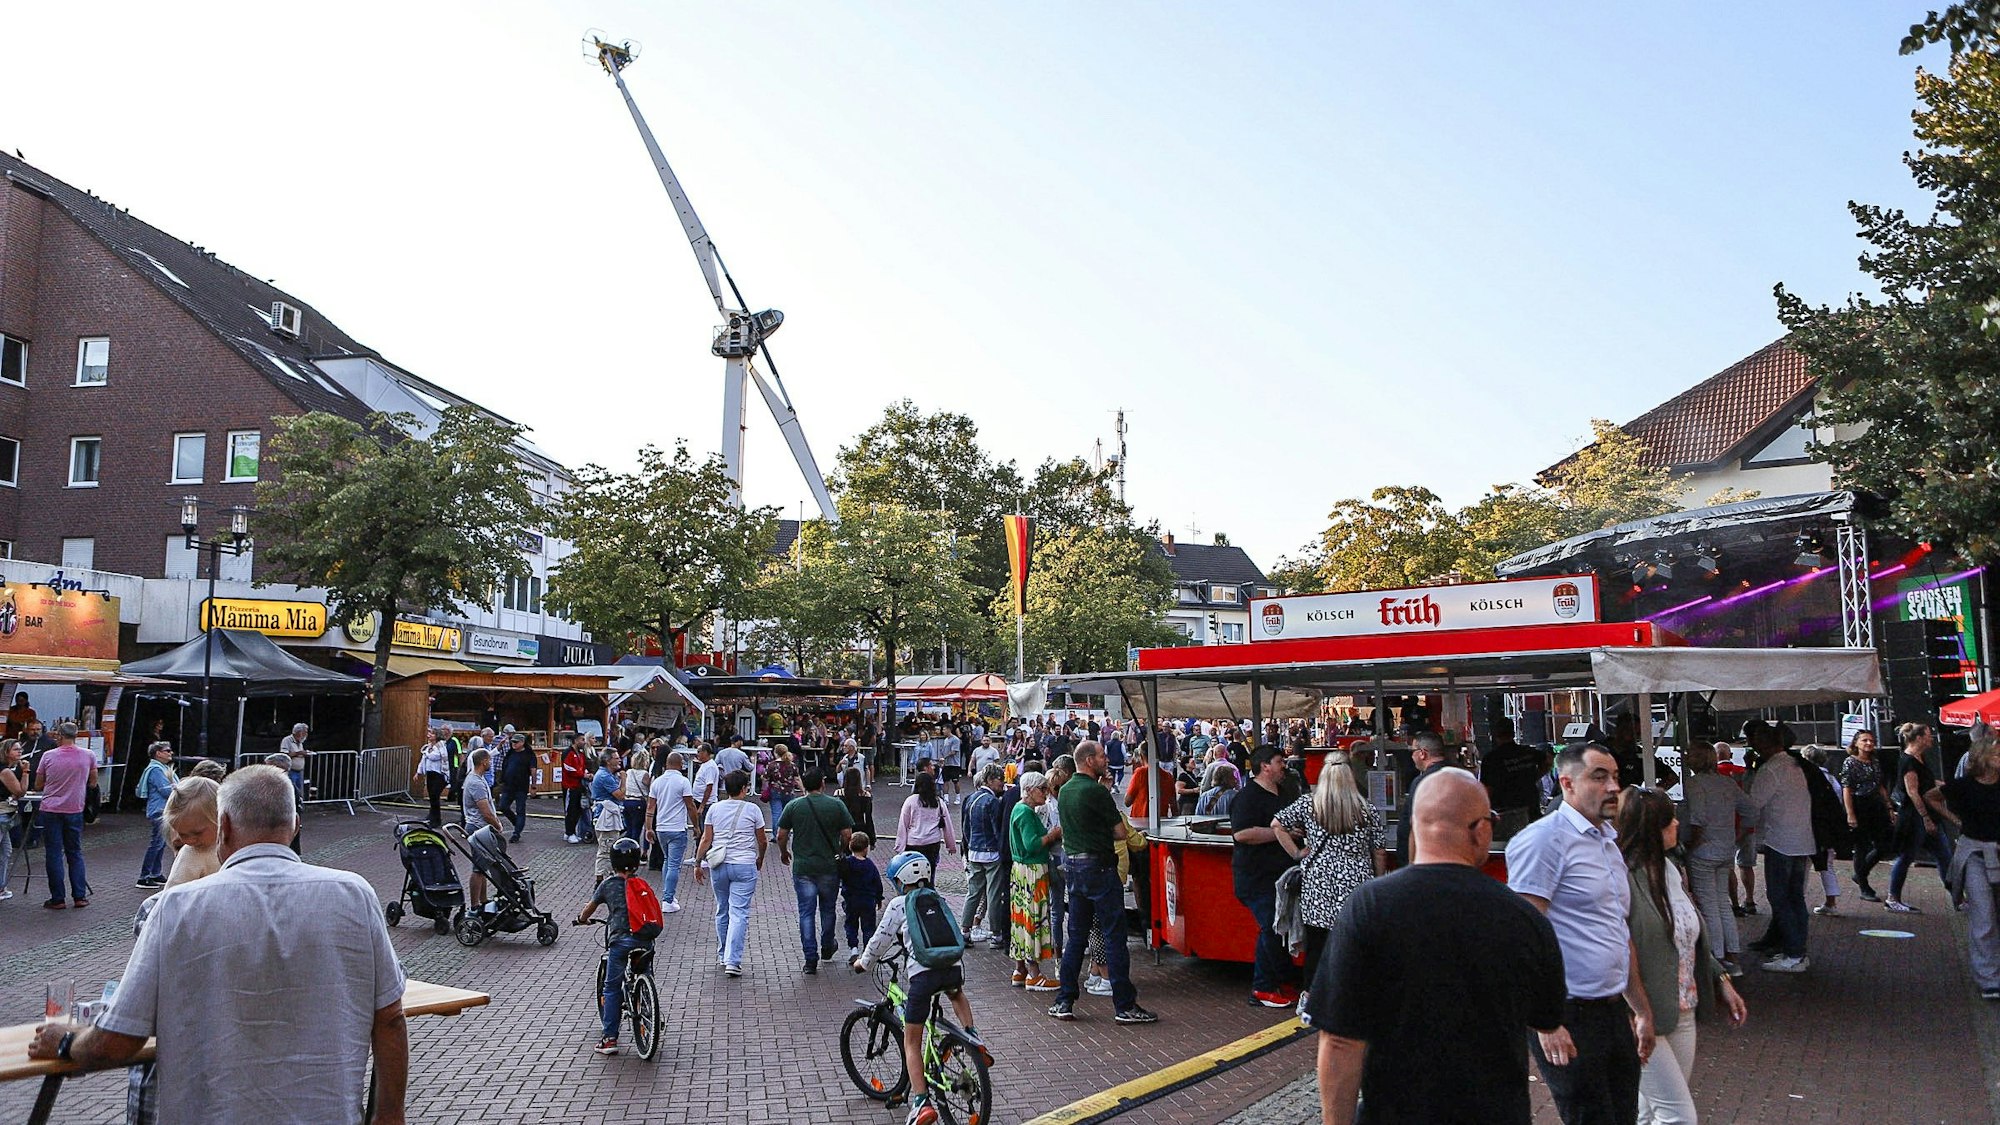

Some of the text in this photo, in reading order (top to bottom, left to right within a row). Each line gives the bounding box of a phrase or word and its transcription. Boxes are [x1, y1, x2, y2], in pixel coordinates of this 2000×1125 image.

[48, 571, 82, 591] dm
[1907, 585, 1961, 604] GENOSSEN
[211, 605, 317, 631] Mamma Mia
[230, 605, 260, 613] Pizzeria
[1307, 609, 1354, 622] KÖLSCH
[1470, 598, 1523, 612] KÖLSCH
[1908, 598, 1962, 620] SCHAFT
[25, 615, 43, 628] BAR
[423, 626, 437, 647] Mia
[563, 645, 595, 666] JULIA
